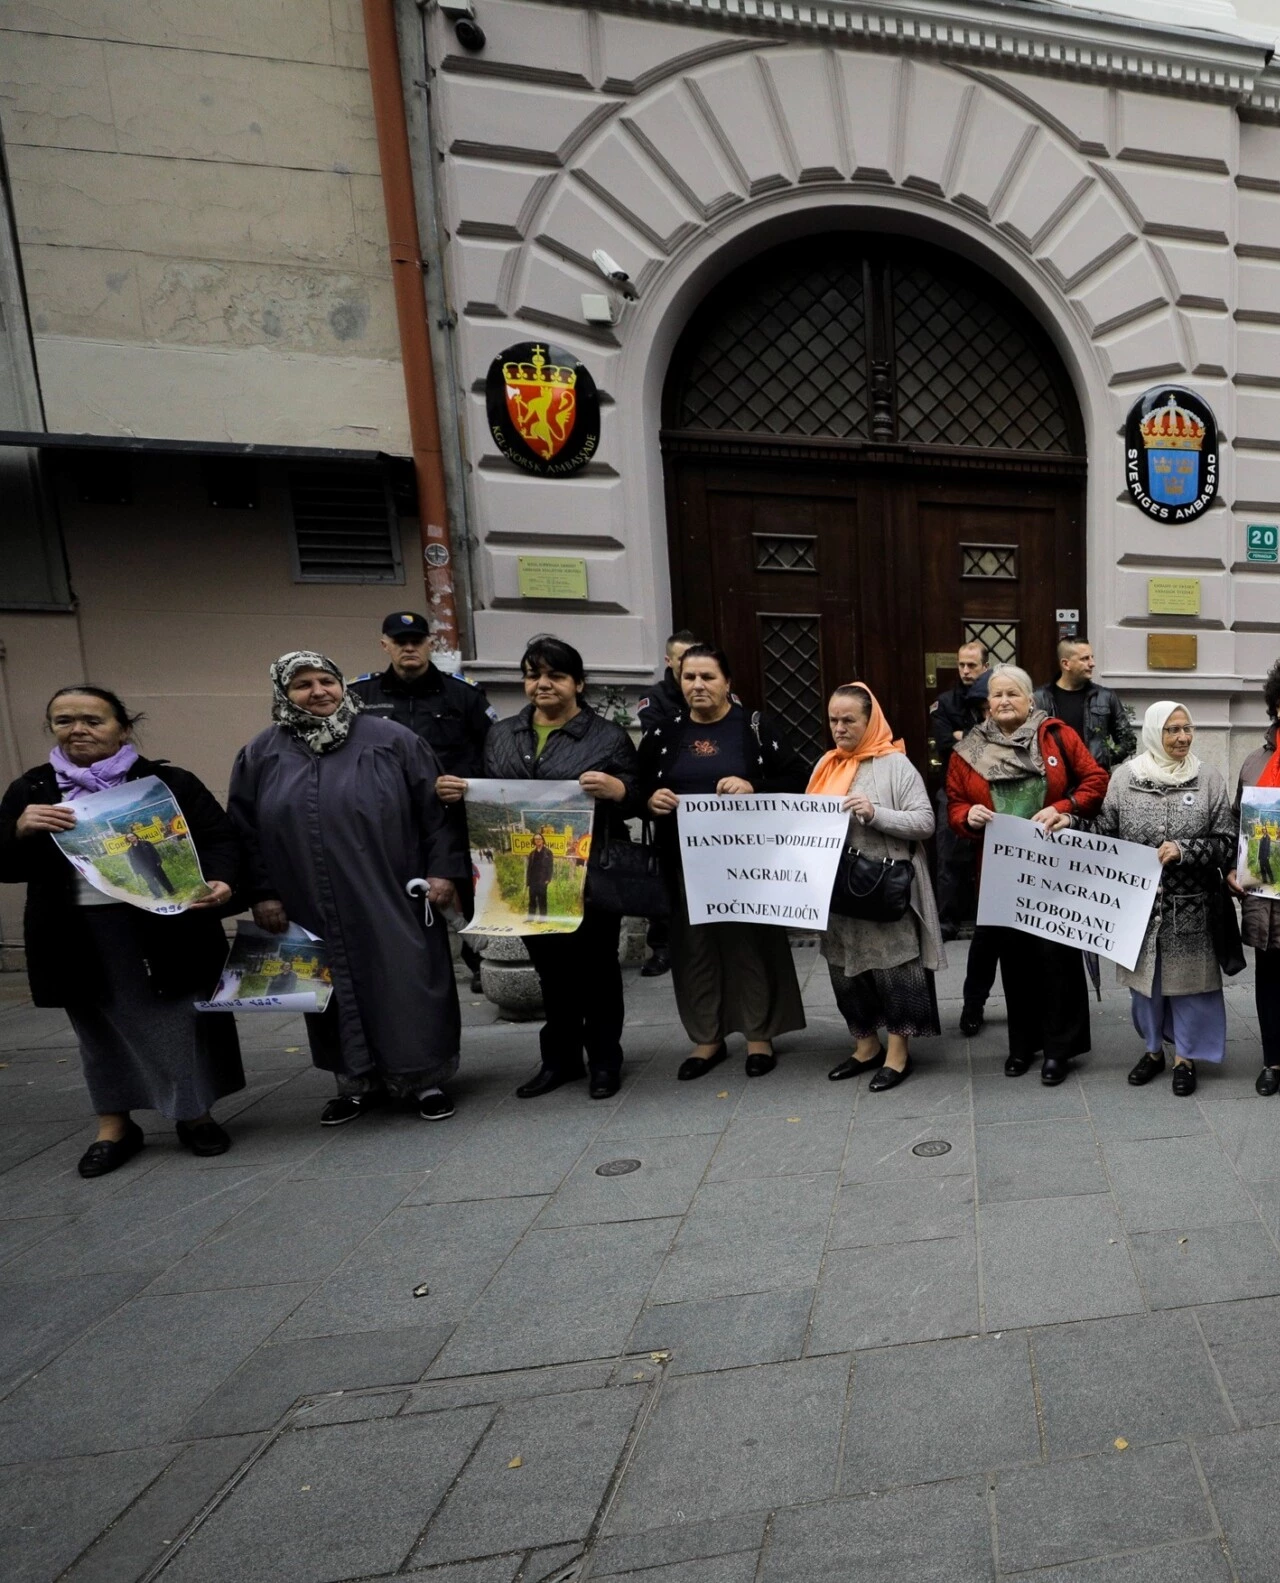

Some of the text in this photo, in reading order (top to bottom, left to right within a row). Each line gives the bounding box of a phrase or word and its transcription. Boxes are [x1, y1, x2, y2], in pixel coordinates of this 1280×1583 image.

[508, 447, 542, 472] NORSK
[547, 434, 597, 473] AMBASSADE
[1128, 448, 1215, 519] SVERIGES AMBASSAD
[1251, 530, 1274, 545] 20
[686, 800, 844, 814] DODIJELITI NAGRADU
[686, 833, 842, 849] HANDKEU=DODIJELITI
[1034, 827, 1119, 855] NAGRADA
[727, 868, 808, 883] NAGRADU ZA
[993, 843, 1152, 891] PETERU HANDKEU
[1017, 872, 1121, 910] JE NAGRADA
[706, 899, 820, 920] POČINJENI ZLOČIN
[1016, 896, 1116, 934] SLOBODANU
[1014, 911, 1115, 952] MILOŠEVIĆU
